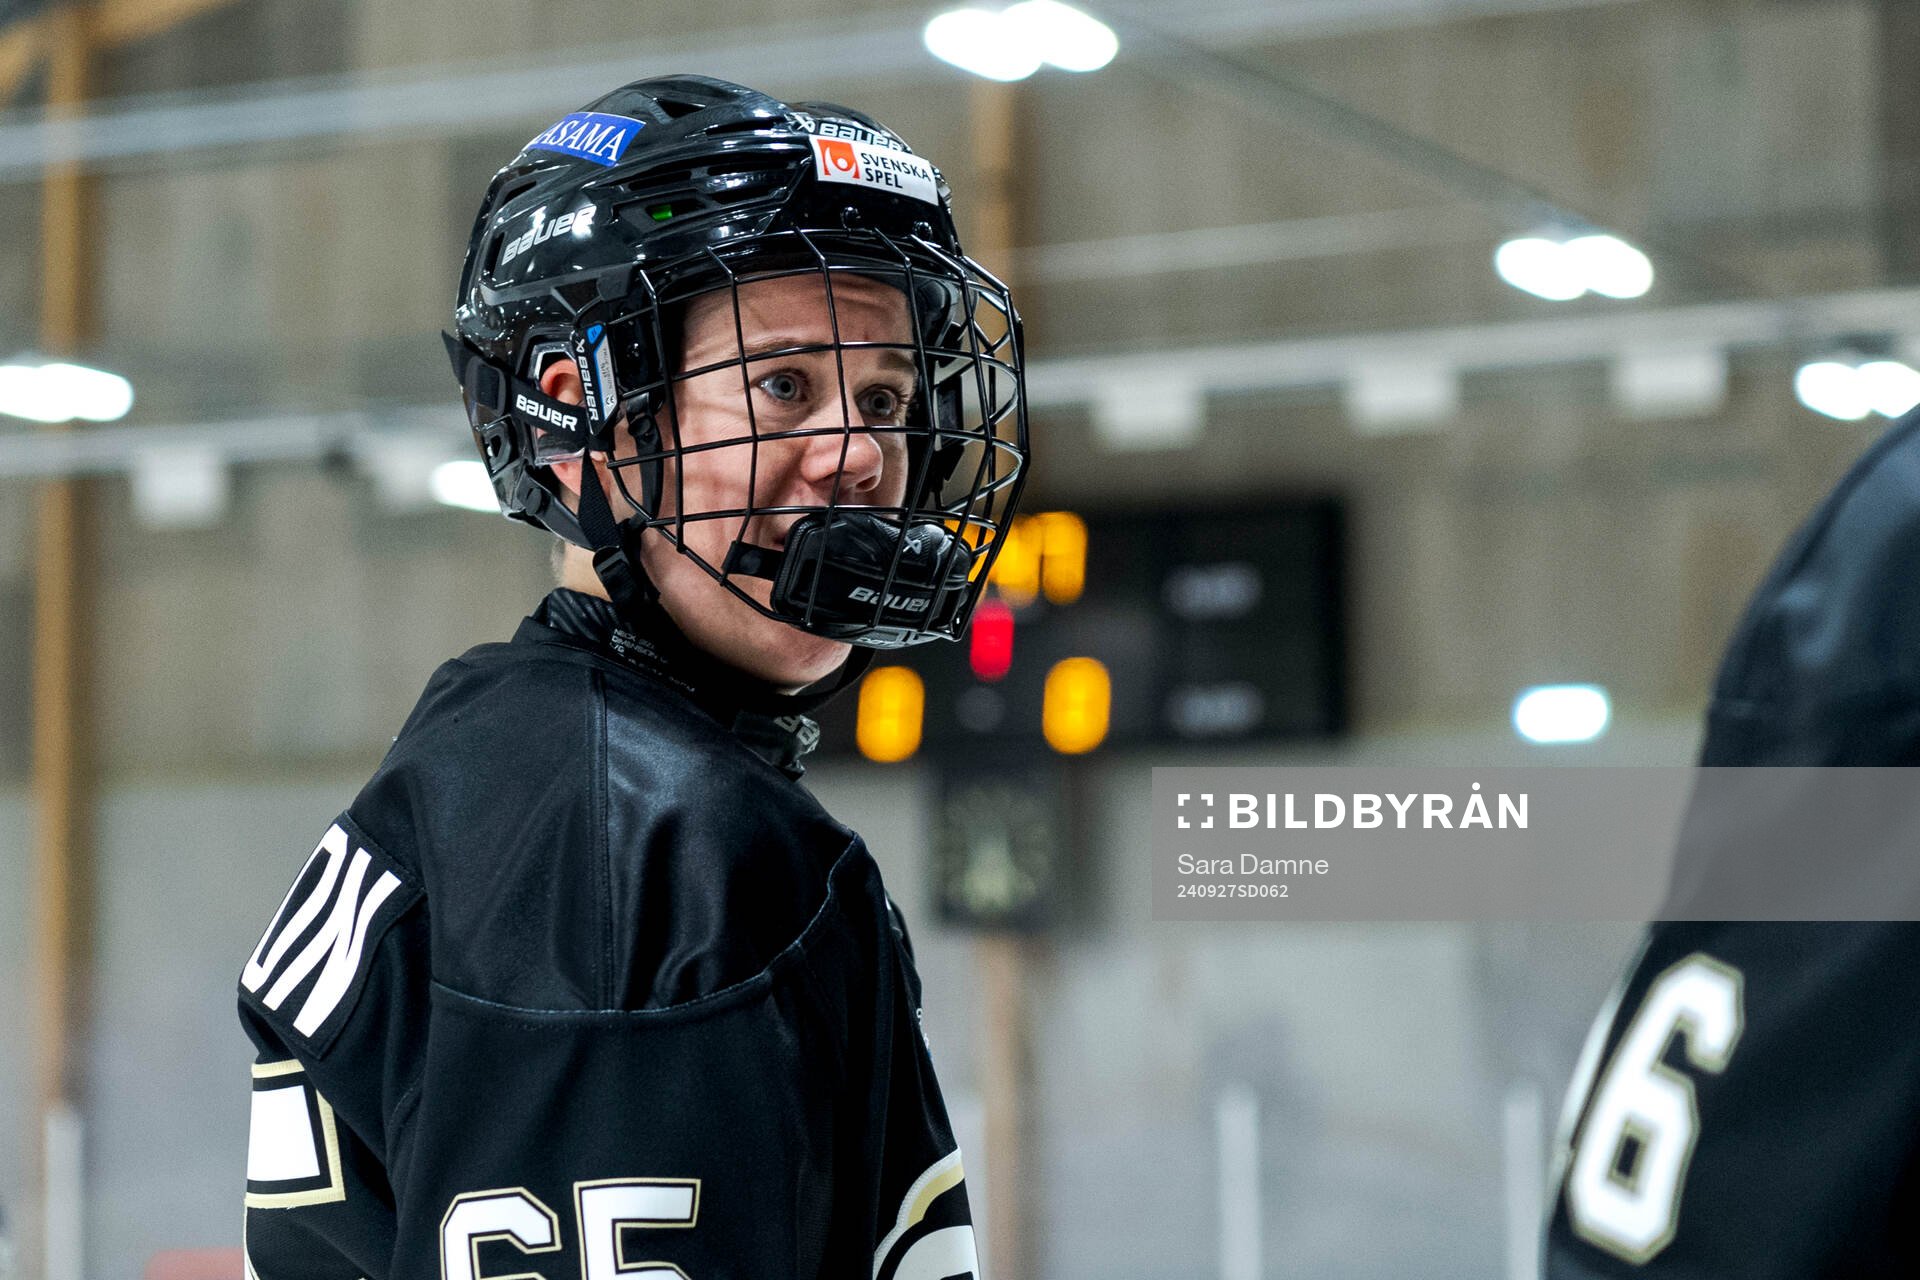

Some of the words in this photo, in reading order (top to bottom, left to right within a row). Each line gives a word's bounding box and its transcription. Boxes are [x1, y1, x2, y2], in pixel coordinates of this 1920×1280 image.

[861, 152, 932, 182] SVENSKA
[865, 168, 903, 189] SPEL
[501, 205, 597, 266] BAUER
[516, 394, 578, 432] BAUER
[578, 356, 600, 421] BAUER
[1568, 952, 1744, 1266] 6
